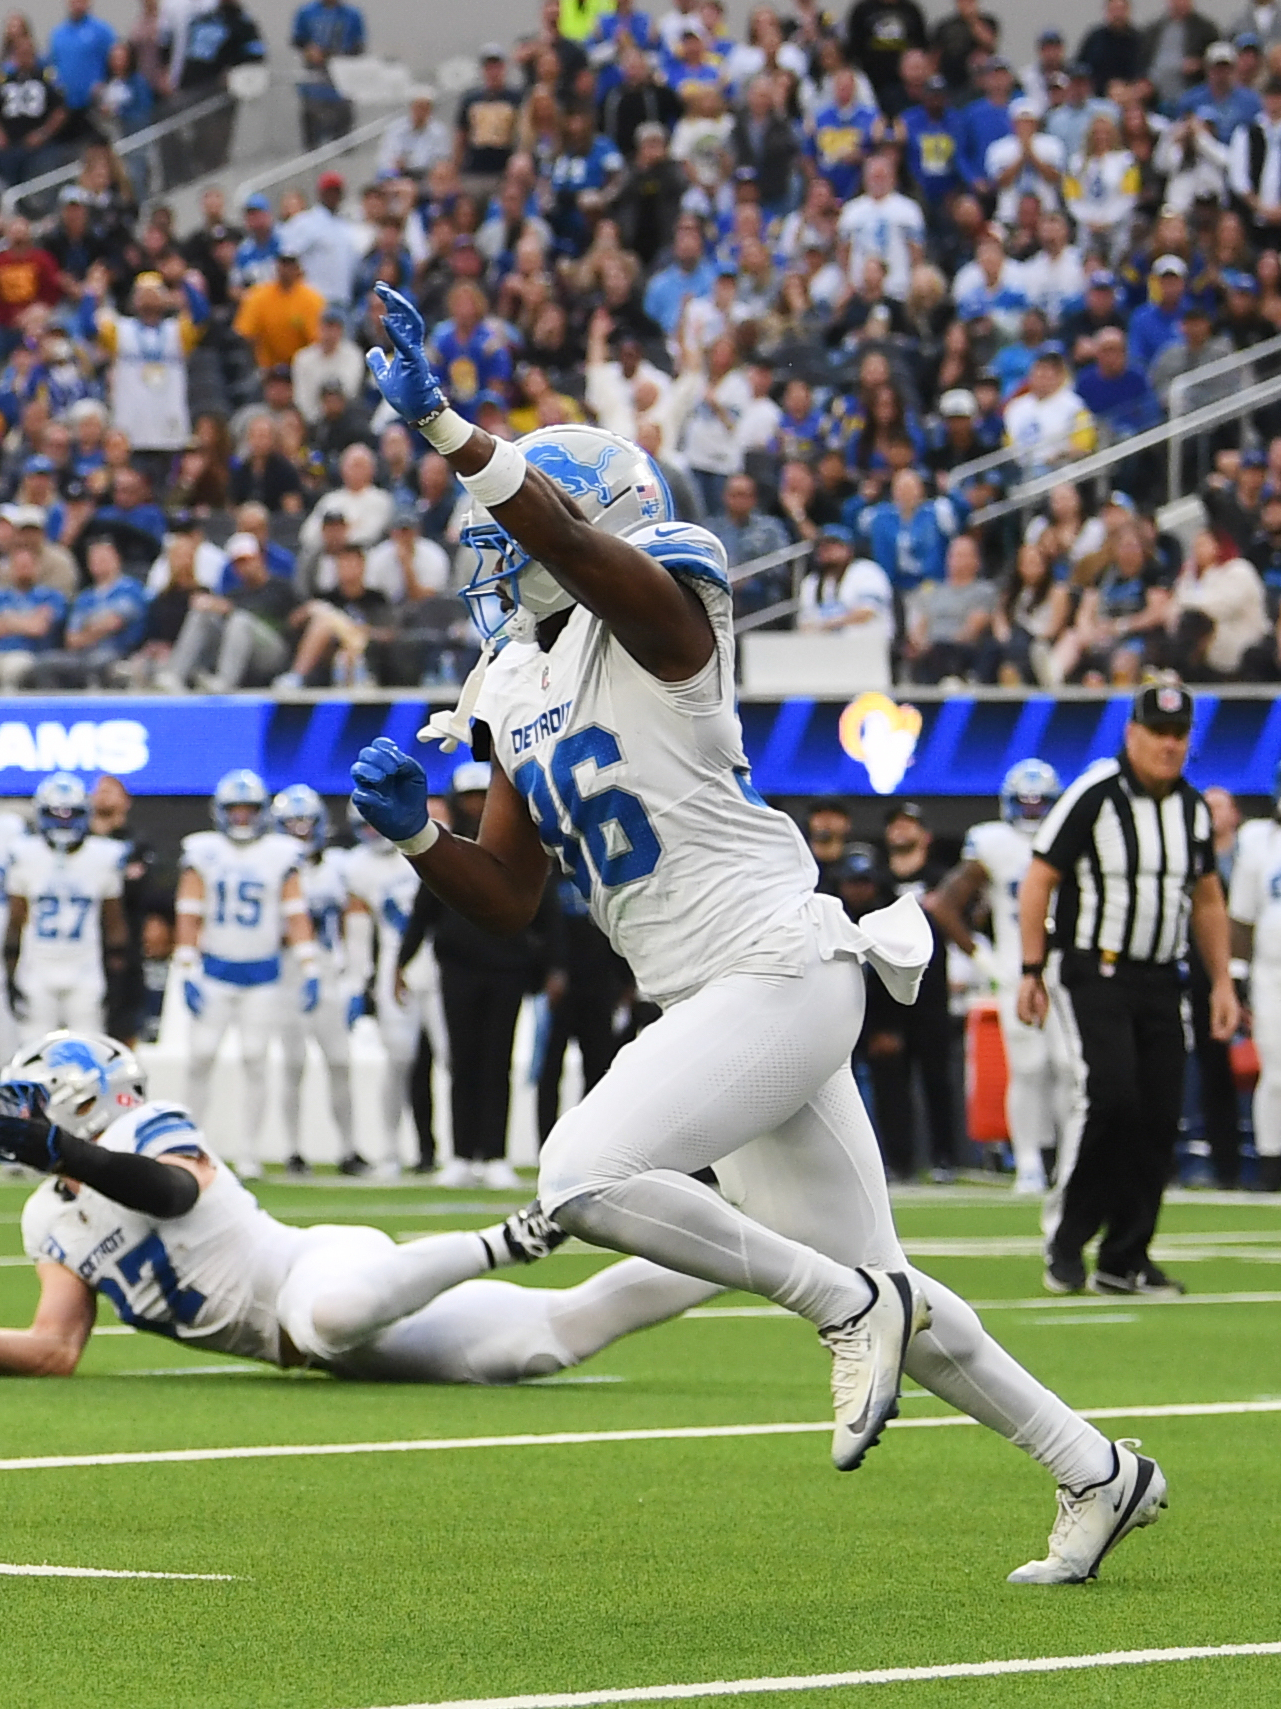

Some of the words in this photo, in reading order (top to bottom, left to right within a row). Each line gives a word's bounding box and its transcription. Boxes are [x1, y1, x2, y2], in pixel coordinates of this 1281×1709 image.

[510, 699, 574, 755] DETROIT
[37, 894, 92, 939] 27
[215, 880, 265, 928] 15
